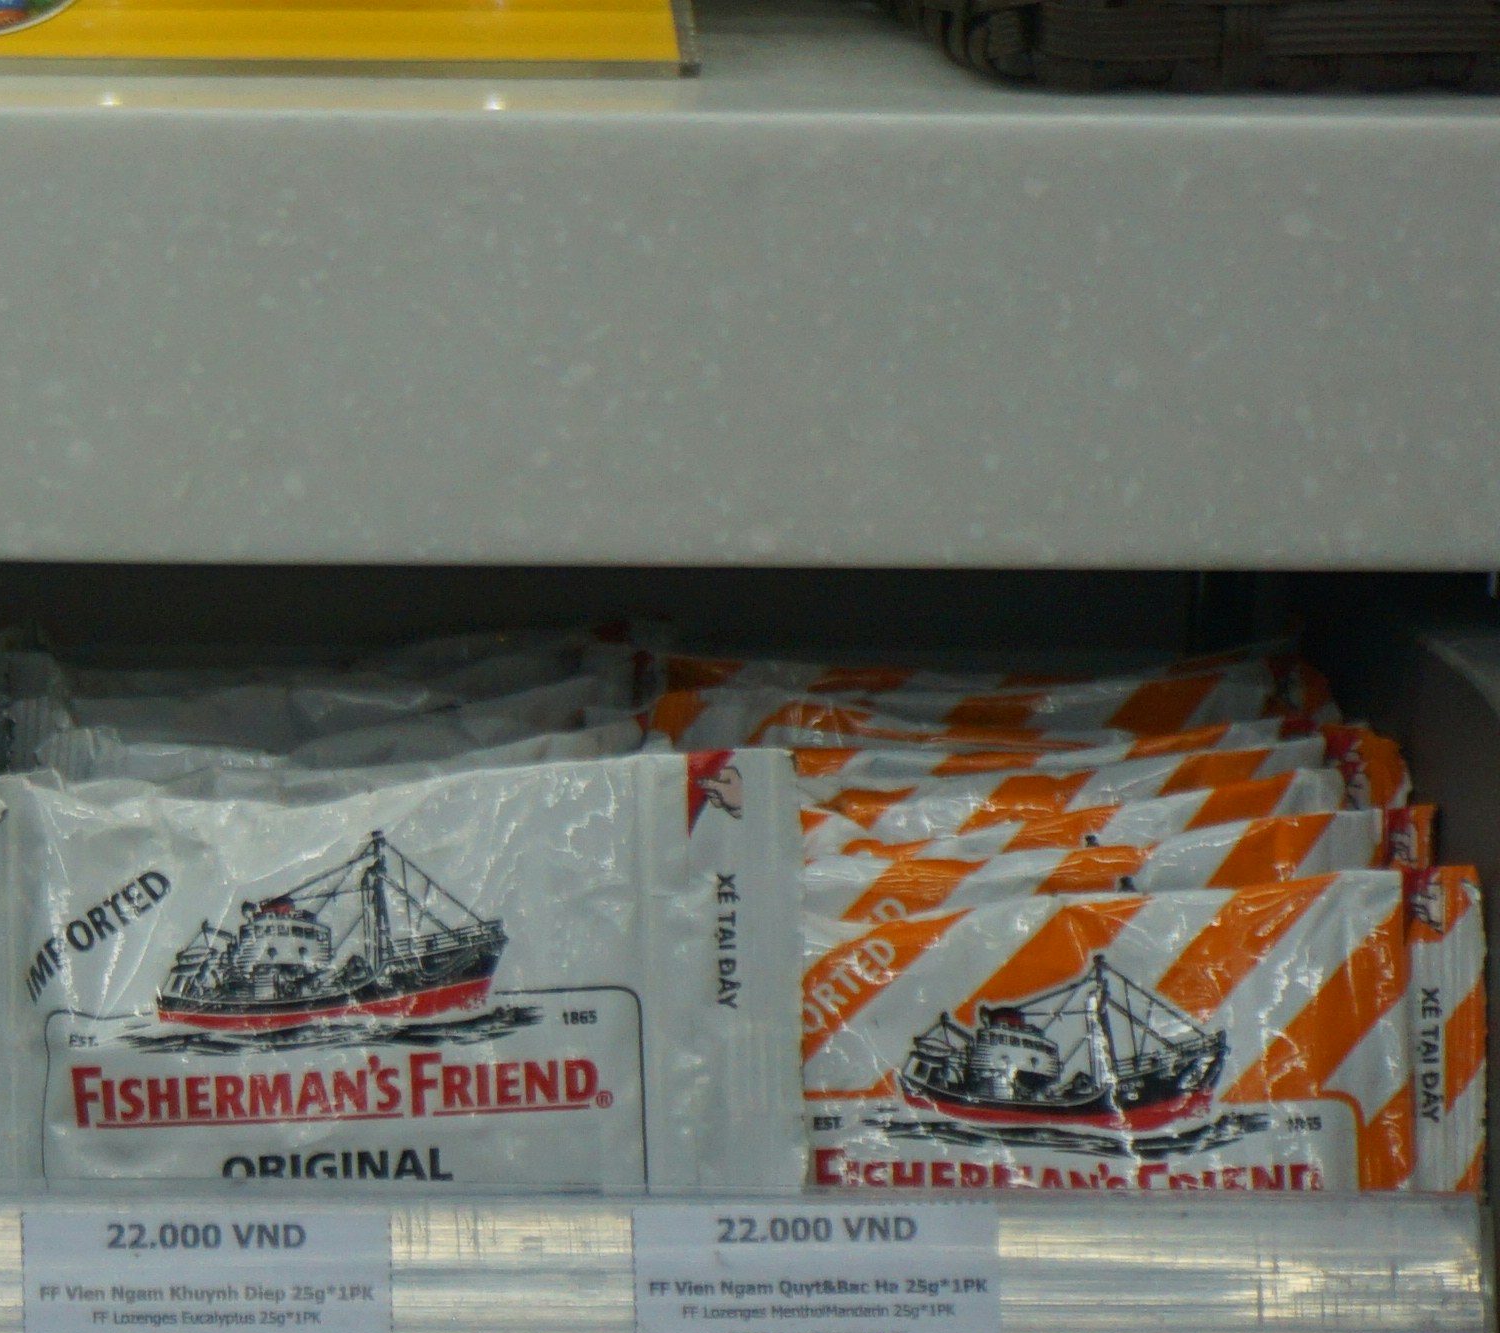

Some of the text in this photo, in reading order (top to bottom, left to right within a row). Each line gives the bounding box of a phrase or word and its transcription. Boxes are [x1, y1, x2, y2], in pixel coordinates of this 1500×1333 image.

[562, 1009, 598, 1027] 1865
[71, 1052, 598, 1129] FISHERMAN'S FRIEND
[107, 1223, 306, 1249] 22.000 VND
[717, 1216, 917, 1243] 22.000 VND
